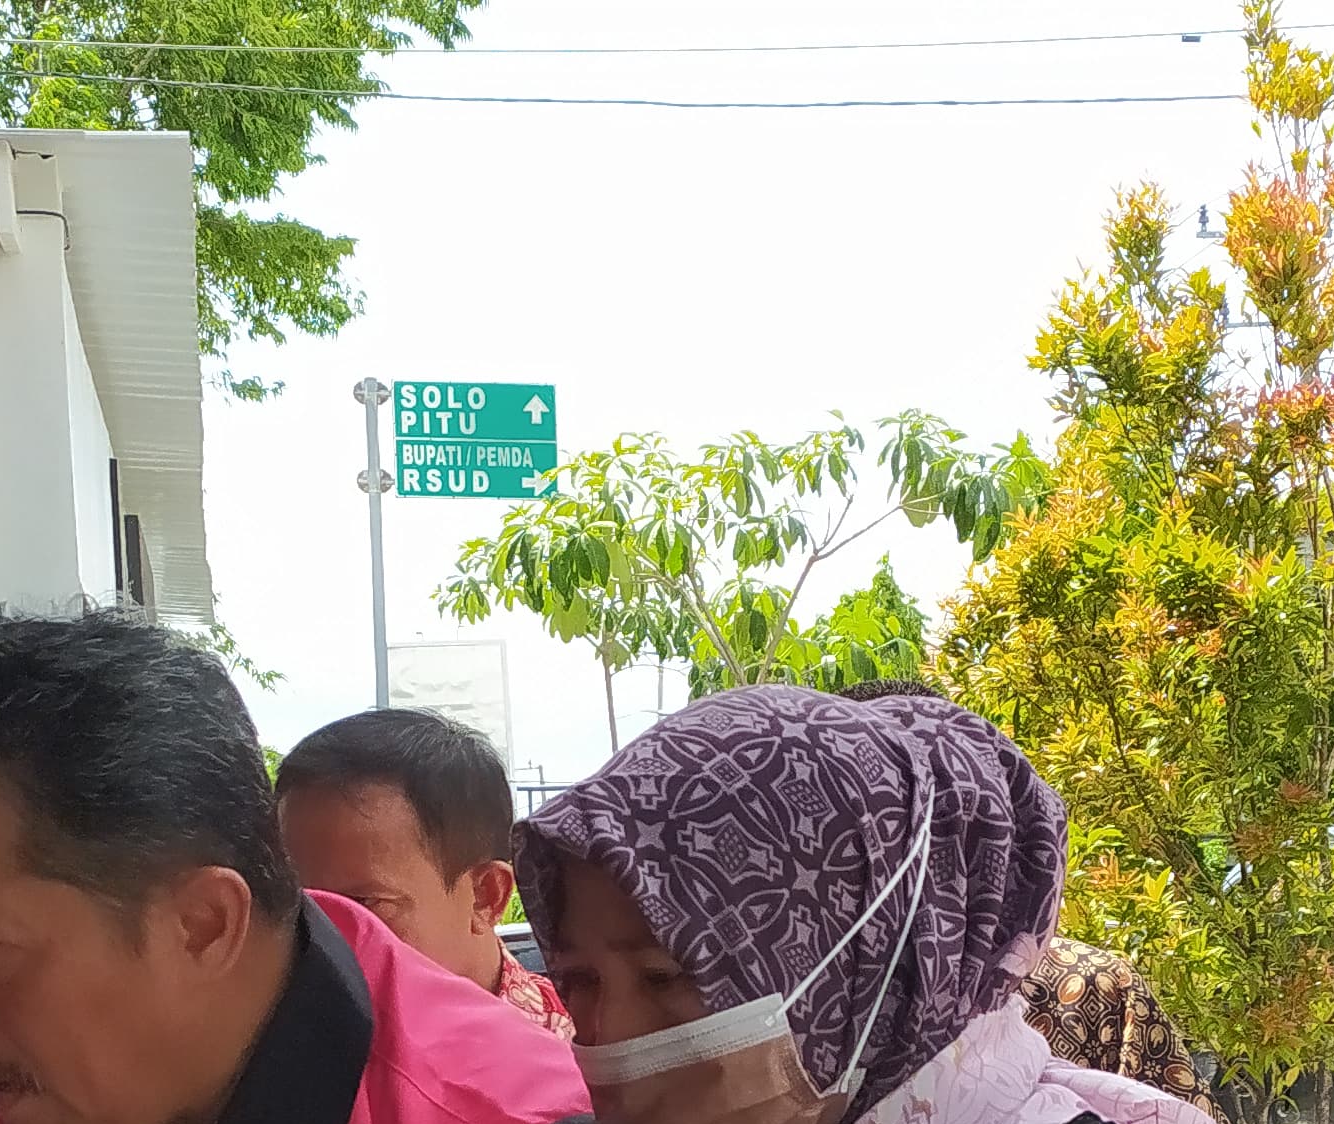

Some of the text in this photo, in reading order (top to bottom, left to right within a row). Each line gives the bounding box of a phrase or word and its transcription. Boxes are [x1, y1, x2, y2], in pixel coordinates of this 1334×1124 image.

[400, 386, 486, 410] SOLO
[400, 411, 477, 435] PITU
[402, 444, 462, 466] BUPATI
[476, 447, 533, 468] PEMDA
[403, 468, 490, 493] RSUD
